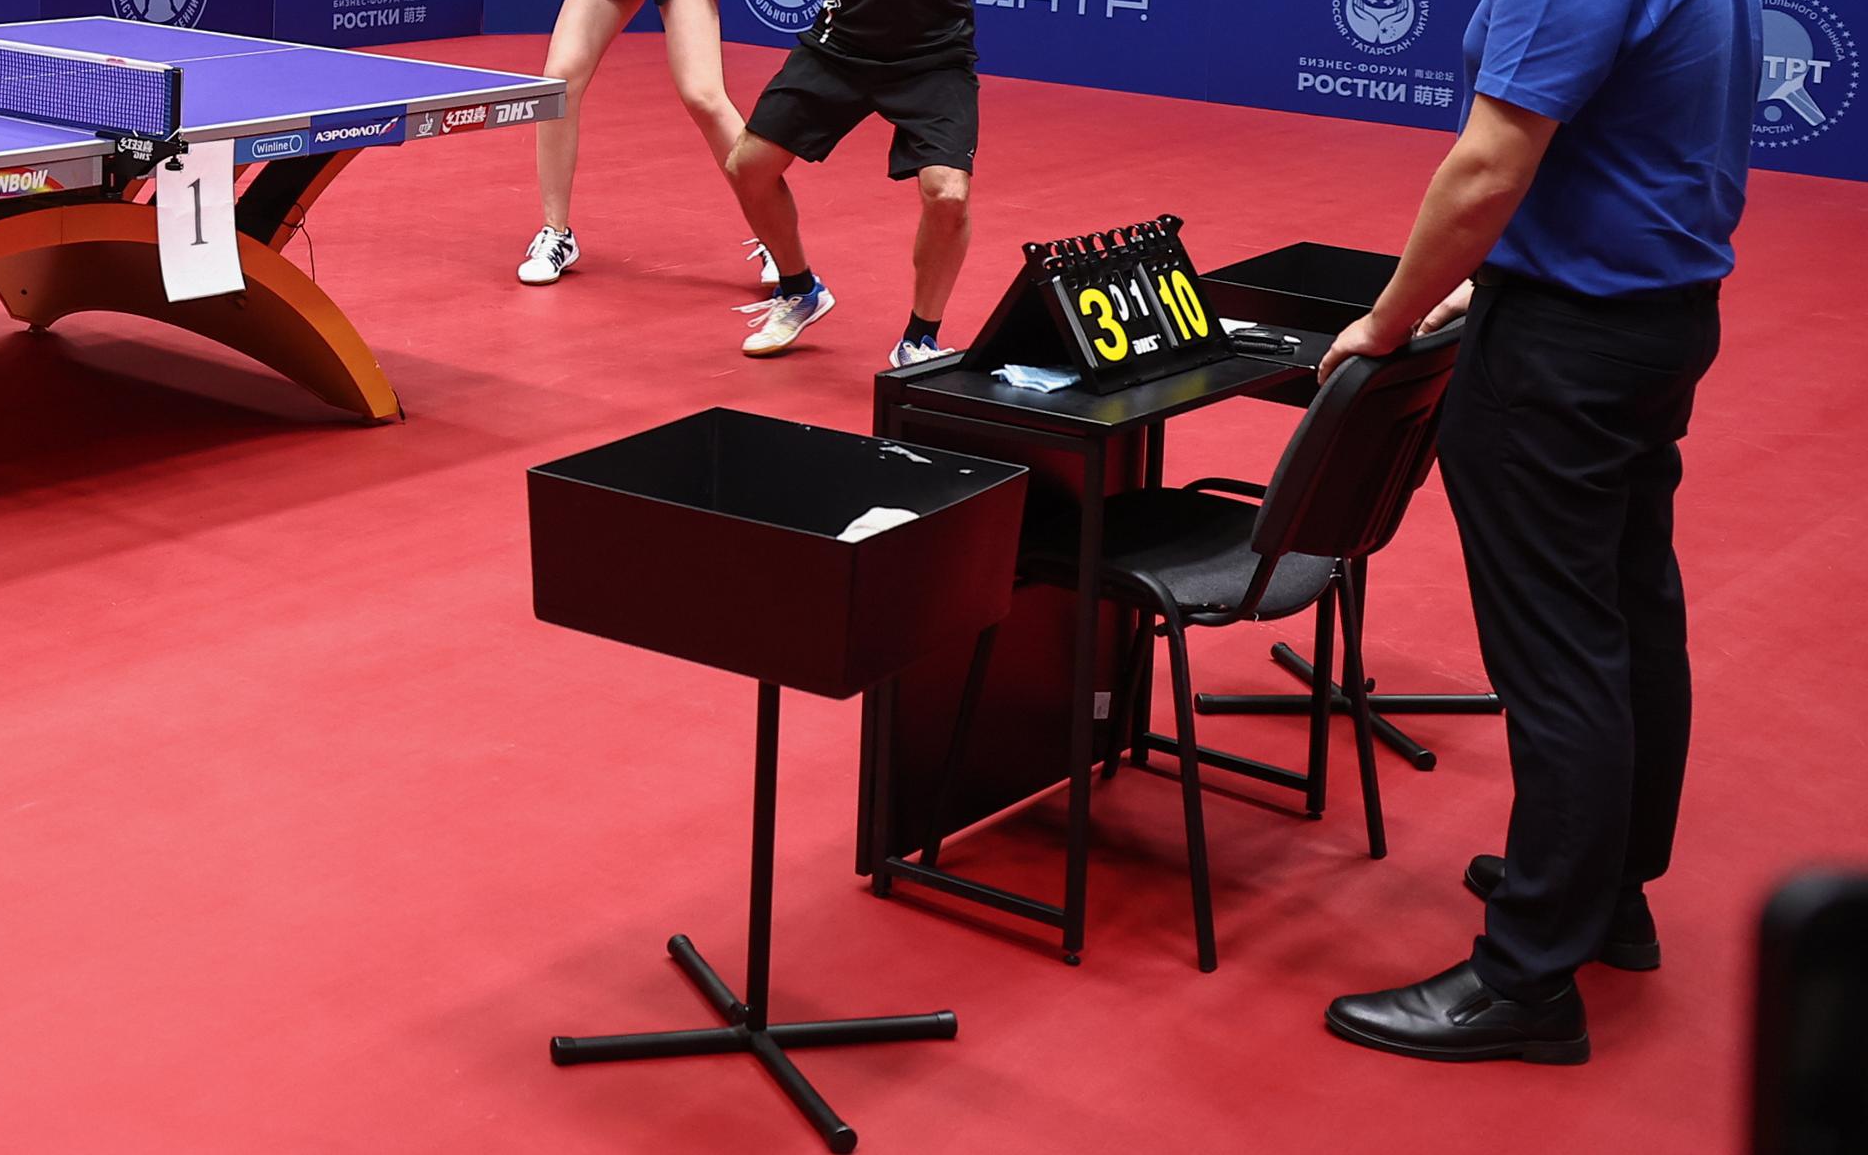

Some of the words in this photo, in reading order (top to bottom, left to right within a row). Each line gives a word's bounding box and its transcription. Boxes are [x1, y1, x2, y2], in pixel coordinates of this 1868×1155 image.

[333, 8, 400, 30] РОСТКИ
[1350, 39, 1412, 56] ТАТАРСТАН
[1412, 0, 1429, 37] КИТАЙ
[1817, 18, 1846, 62] ТЕННИСА
[1299, 56, 1408, 77] БИЗНЕС-ФОРУМ
[1763, 55, 1831, 84] ТРТ
[1297, 72, 1406, 102] РОСТКИ
[1413, 85, 1454, 108] 萌芽
[445, 105, 487, 129] 红双喜
[495, 100, 539, 124] DHS
[1751, 123, 1794, 134] ТАРСТАН
[257, 138, 289, 154] Winline
[314, 124, 381, 143] АЭРОФЛОТ
[188, 178, 209, 246] 1
[1079, 288, 1128, 361] 3
[1130, 279, 1150, 316] 1
[1158, 270, 1209, 340] 10
